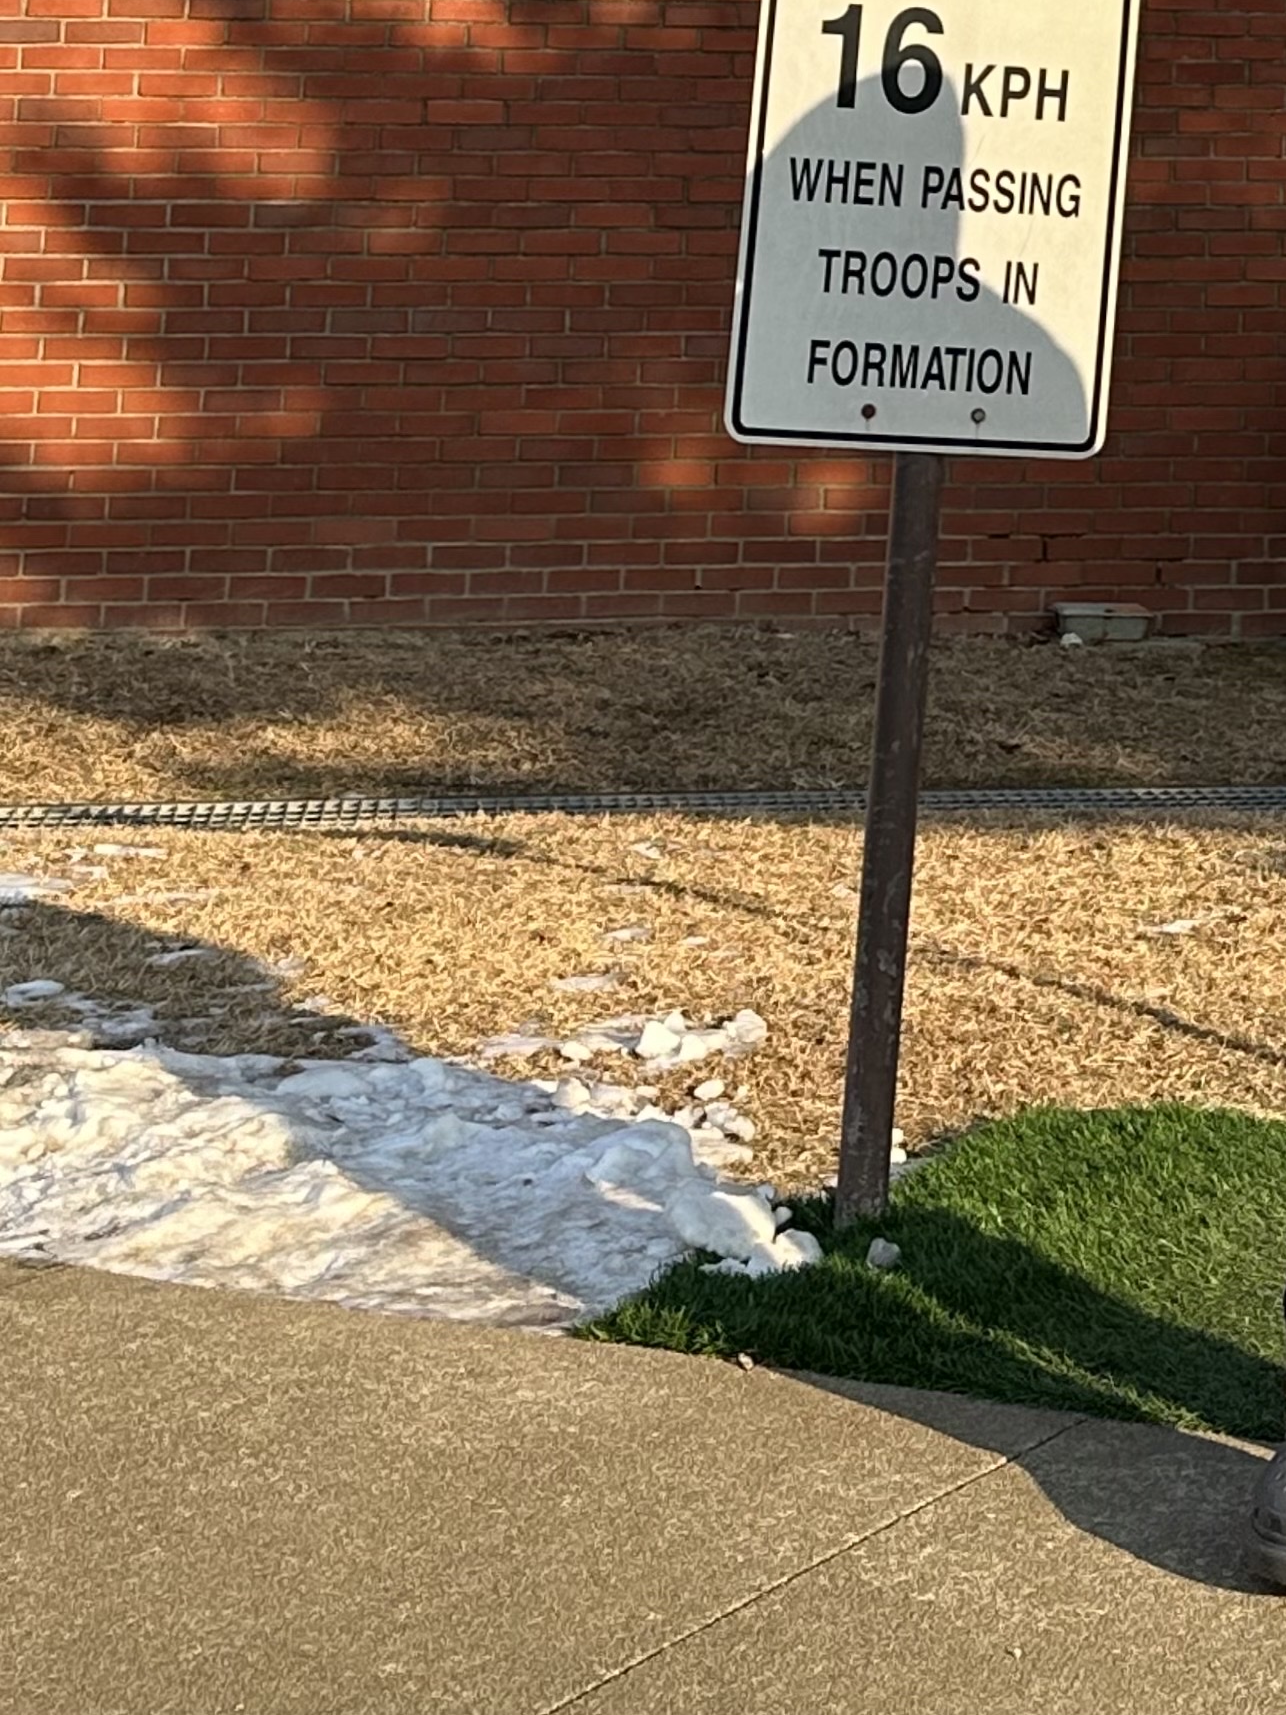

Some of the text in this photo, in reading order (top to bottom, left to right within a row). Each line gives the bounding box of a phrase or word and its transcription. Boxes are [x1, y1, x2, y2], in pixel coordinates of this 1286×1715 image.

[821, 3, 1070, 123] 16 KPH
[789, 156, 1082, 218] WHEN PASSING
[818, 248, 1039, 305] TROOPS IN
[806, 339, 1032, 396] FORMATION
